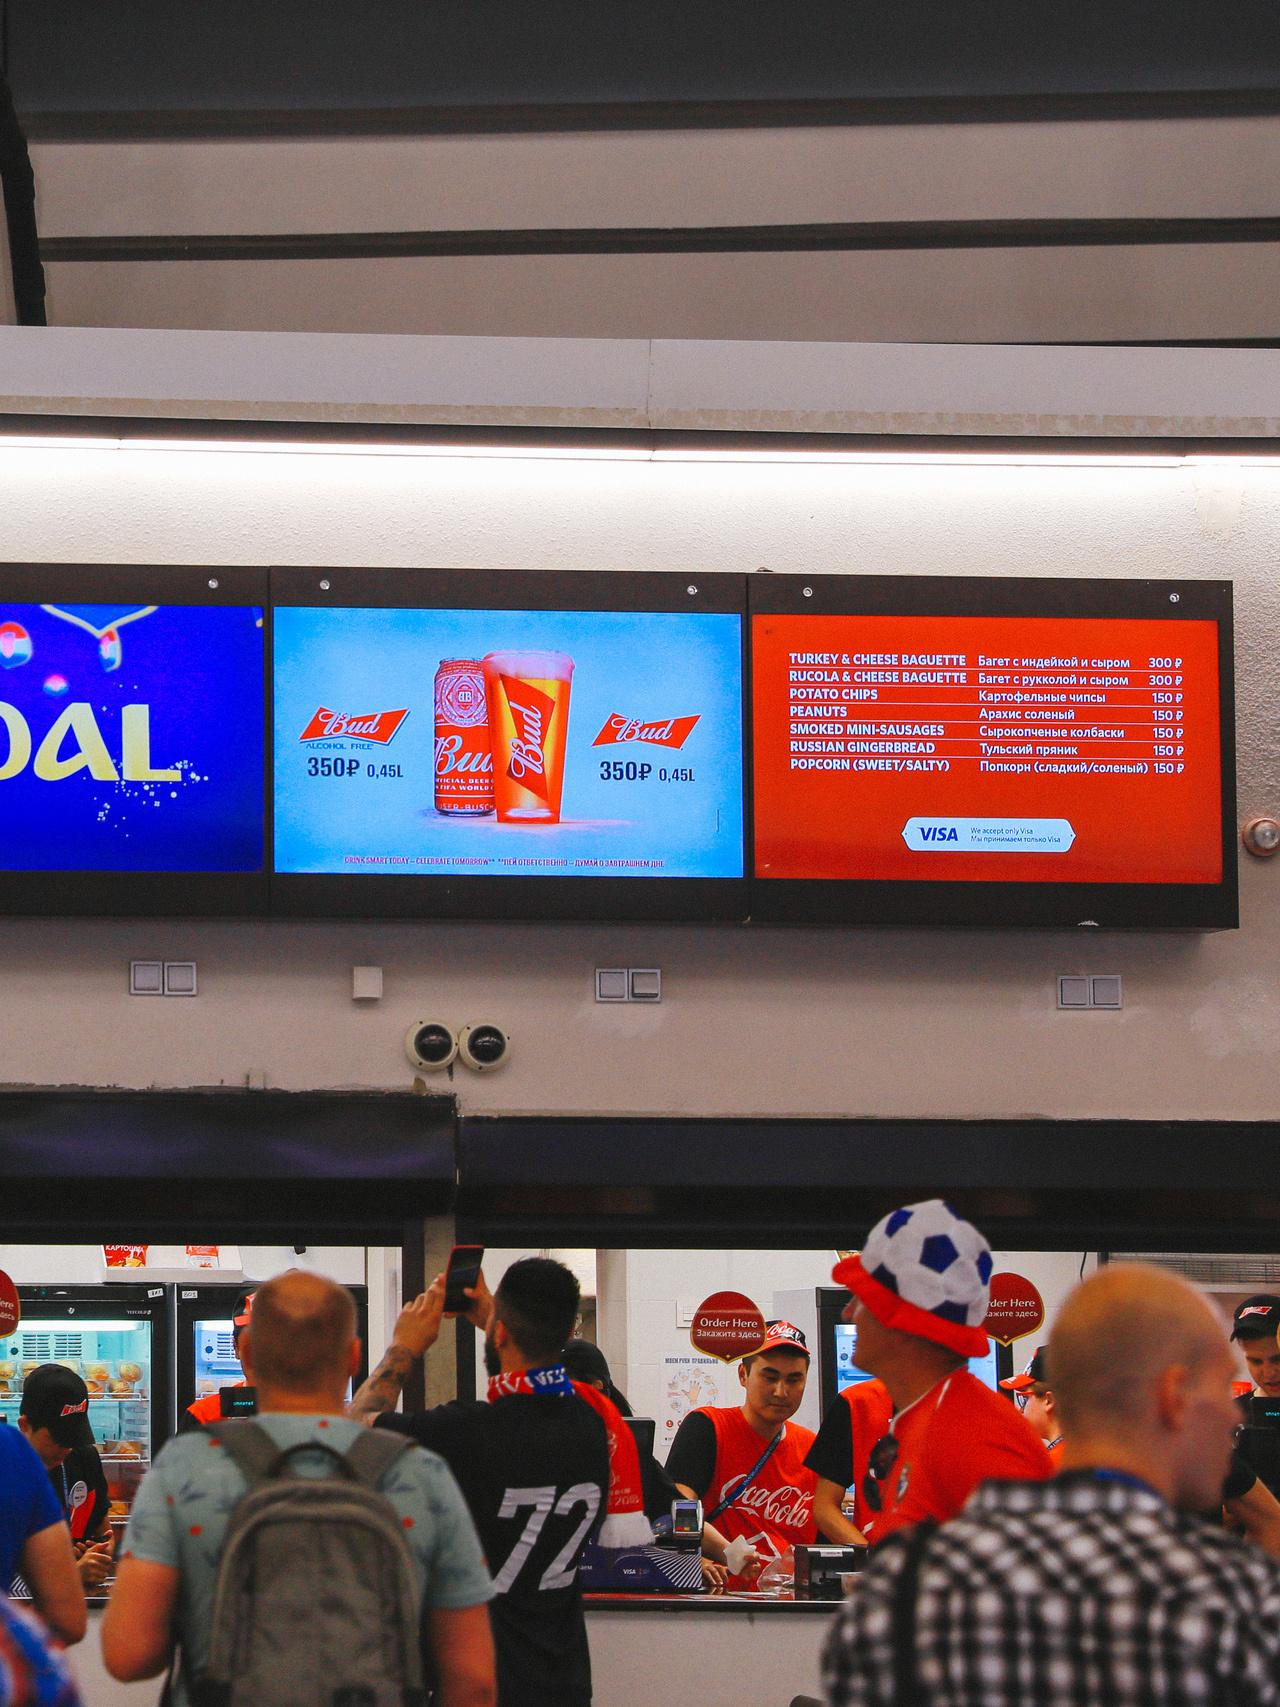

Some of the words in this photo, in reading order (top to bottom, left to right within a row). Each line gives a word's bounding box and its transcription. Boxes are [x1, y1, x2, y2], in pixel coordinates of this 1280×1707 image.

[789, 653, 839, 665] TURKEY
[841, 653, 850, 664] &
[853, 653, 898, 665] CHEESE
[902, 654, 966, 666] BAGUETTE
[978, 655, 1010, 667] Багет
[1013, 658, 1019, 666] с
[1022, 656, 1078, 669] индейкой
[1081, 659, 1088, 667] и
[1091, 659, 1130, 670] сыром
[789, 670, 840, 682] RUCOLA
[842, 671, 851, 682] &
[854, 671, 899, 683] CHEESE
[902, 671, 967, 684] BAGUETTE
[979, 672, 1011, 684] Багет
[1013, 676, 1019, 684] с
[1022, 673, 1077, 687] рукколой
[1080, 676, 1087, 685] и
[1090, 676, 1129, 688] сыром
[790, 688, 839, 700] POTATO
[842, 688, 878, 700] CHIPS
[979, 690, 1067, 704] Картофельные
[1069, 694, 1105, 703] чипсы
[790, 705, 847, 717] PEANUTS
[979, 707, 1022, 721] Арахис
[1024, 709, 1075, 720] соленый
[318, 711, 382, 735] Bud
[611, 717, 675, 742] Bud
[790, 723, 844, 735] SMOKED
[847, 723, 944, 736] MINI-SAUSAGES
[979, 725, 1068, 739] Сырокопченые
[1070, 726, 1124, 738] колбаски
[509, 701, 544, 778] Bud
[790, 740, 844, 753] RUSSIAN
[847, 741, 935, 754] GINGERBREAD
[979, 743, 1033, 756] Тульский
[1036, 746, 1078, 756] пряник
[367, 764, 404, 779] 0,45L
[791, 758, 850, 770] POPCORN
[853, 758, 950, 773] (SWEET/SALTY)
[980, 760, 1031, 774] Попкорн
[1034, 760, 1148, 776] (сладкий/соленый)
[659, 768, 696, 783] 0,45L
[917, 827, 958, 842] VISA
[982, 828, 1004, 836] accept
[983, 836, 1023, 844] принимаем
[1010, 1298, 1036, 1308] Here
[700, 1318, 730, 1328] Order
[732, 1318, 758, 1328] Here
[697, 1329, 736, 1338] Закажите
[738, 1331, 762, 1339] здесь
[493, 1482, 601, 1594] 72
